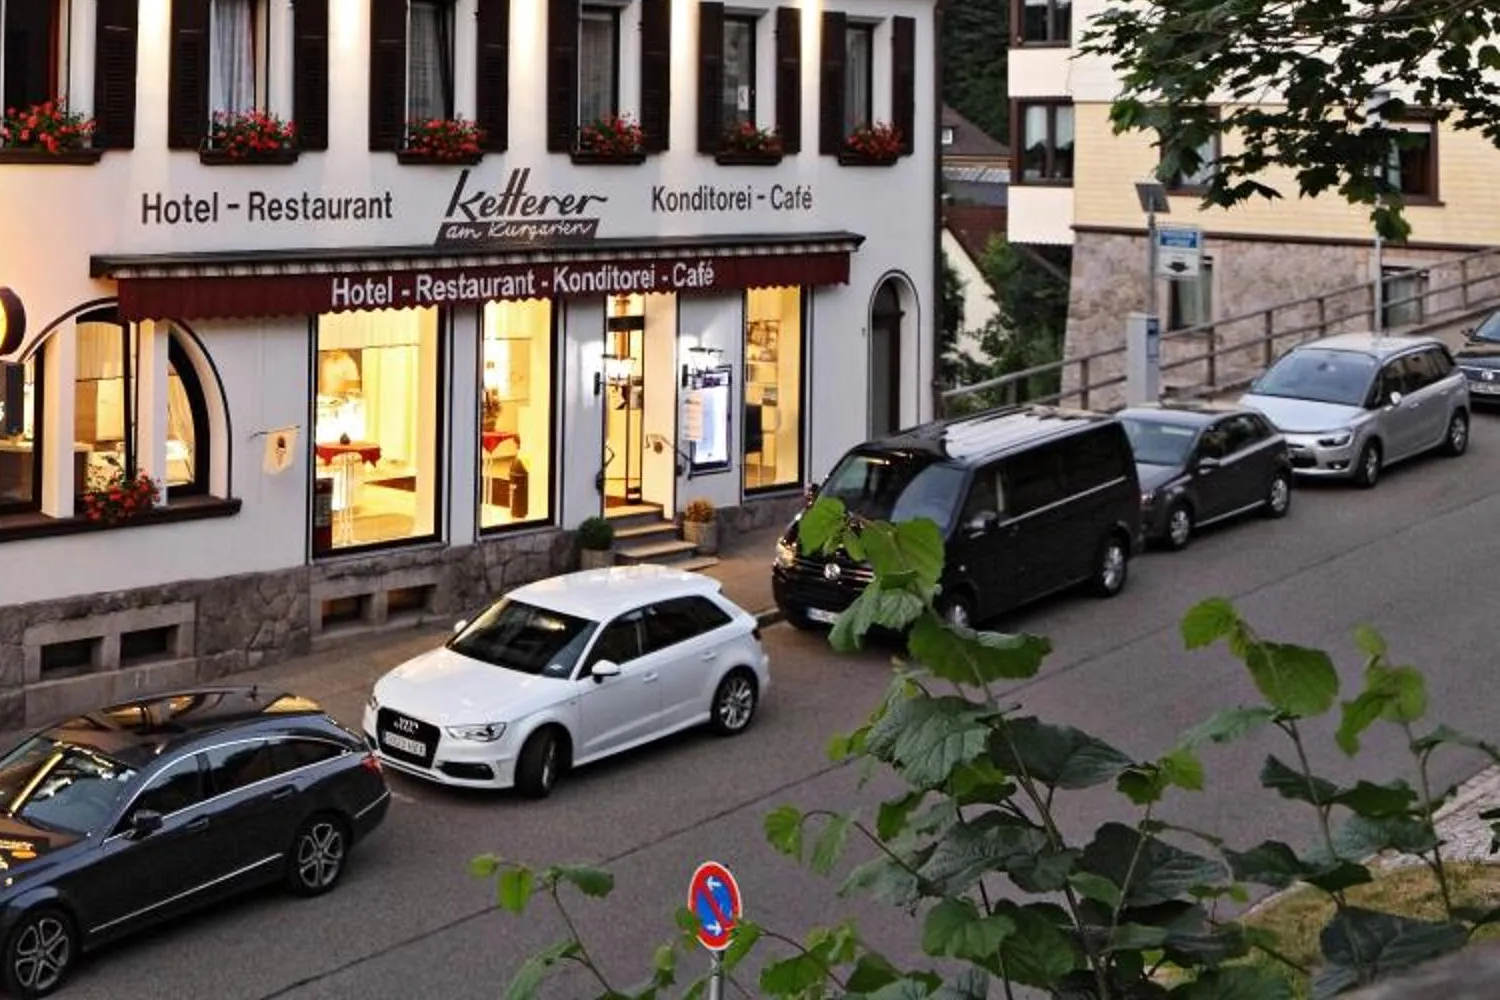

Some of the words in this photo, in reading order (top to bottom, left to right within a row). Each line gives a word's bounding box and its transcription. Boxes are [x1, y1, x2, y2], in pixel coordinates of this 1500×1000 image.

[142, 191, 218, 224] Hotel
[248, 190, 393, 221] Restaurant
[652, 185, 752, 212] Konditorei
[770, 184, 813, 210] Café
[445, 225, 481, 239] am
[331, 275, 393, 307] Hotel
[415, 269, 536, 302] Restaurant
[553, 263, 656, 293] Konditorei
[672, 260, 714, 288] Café
